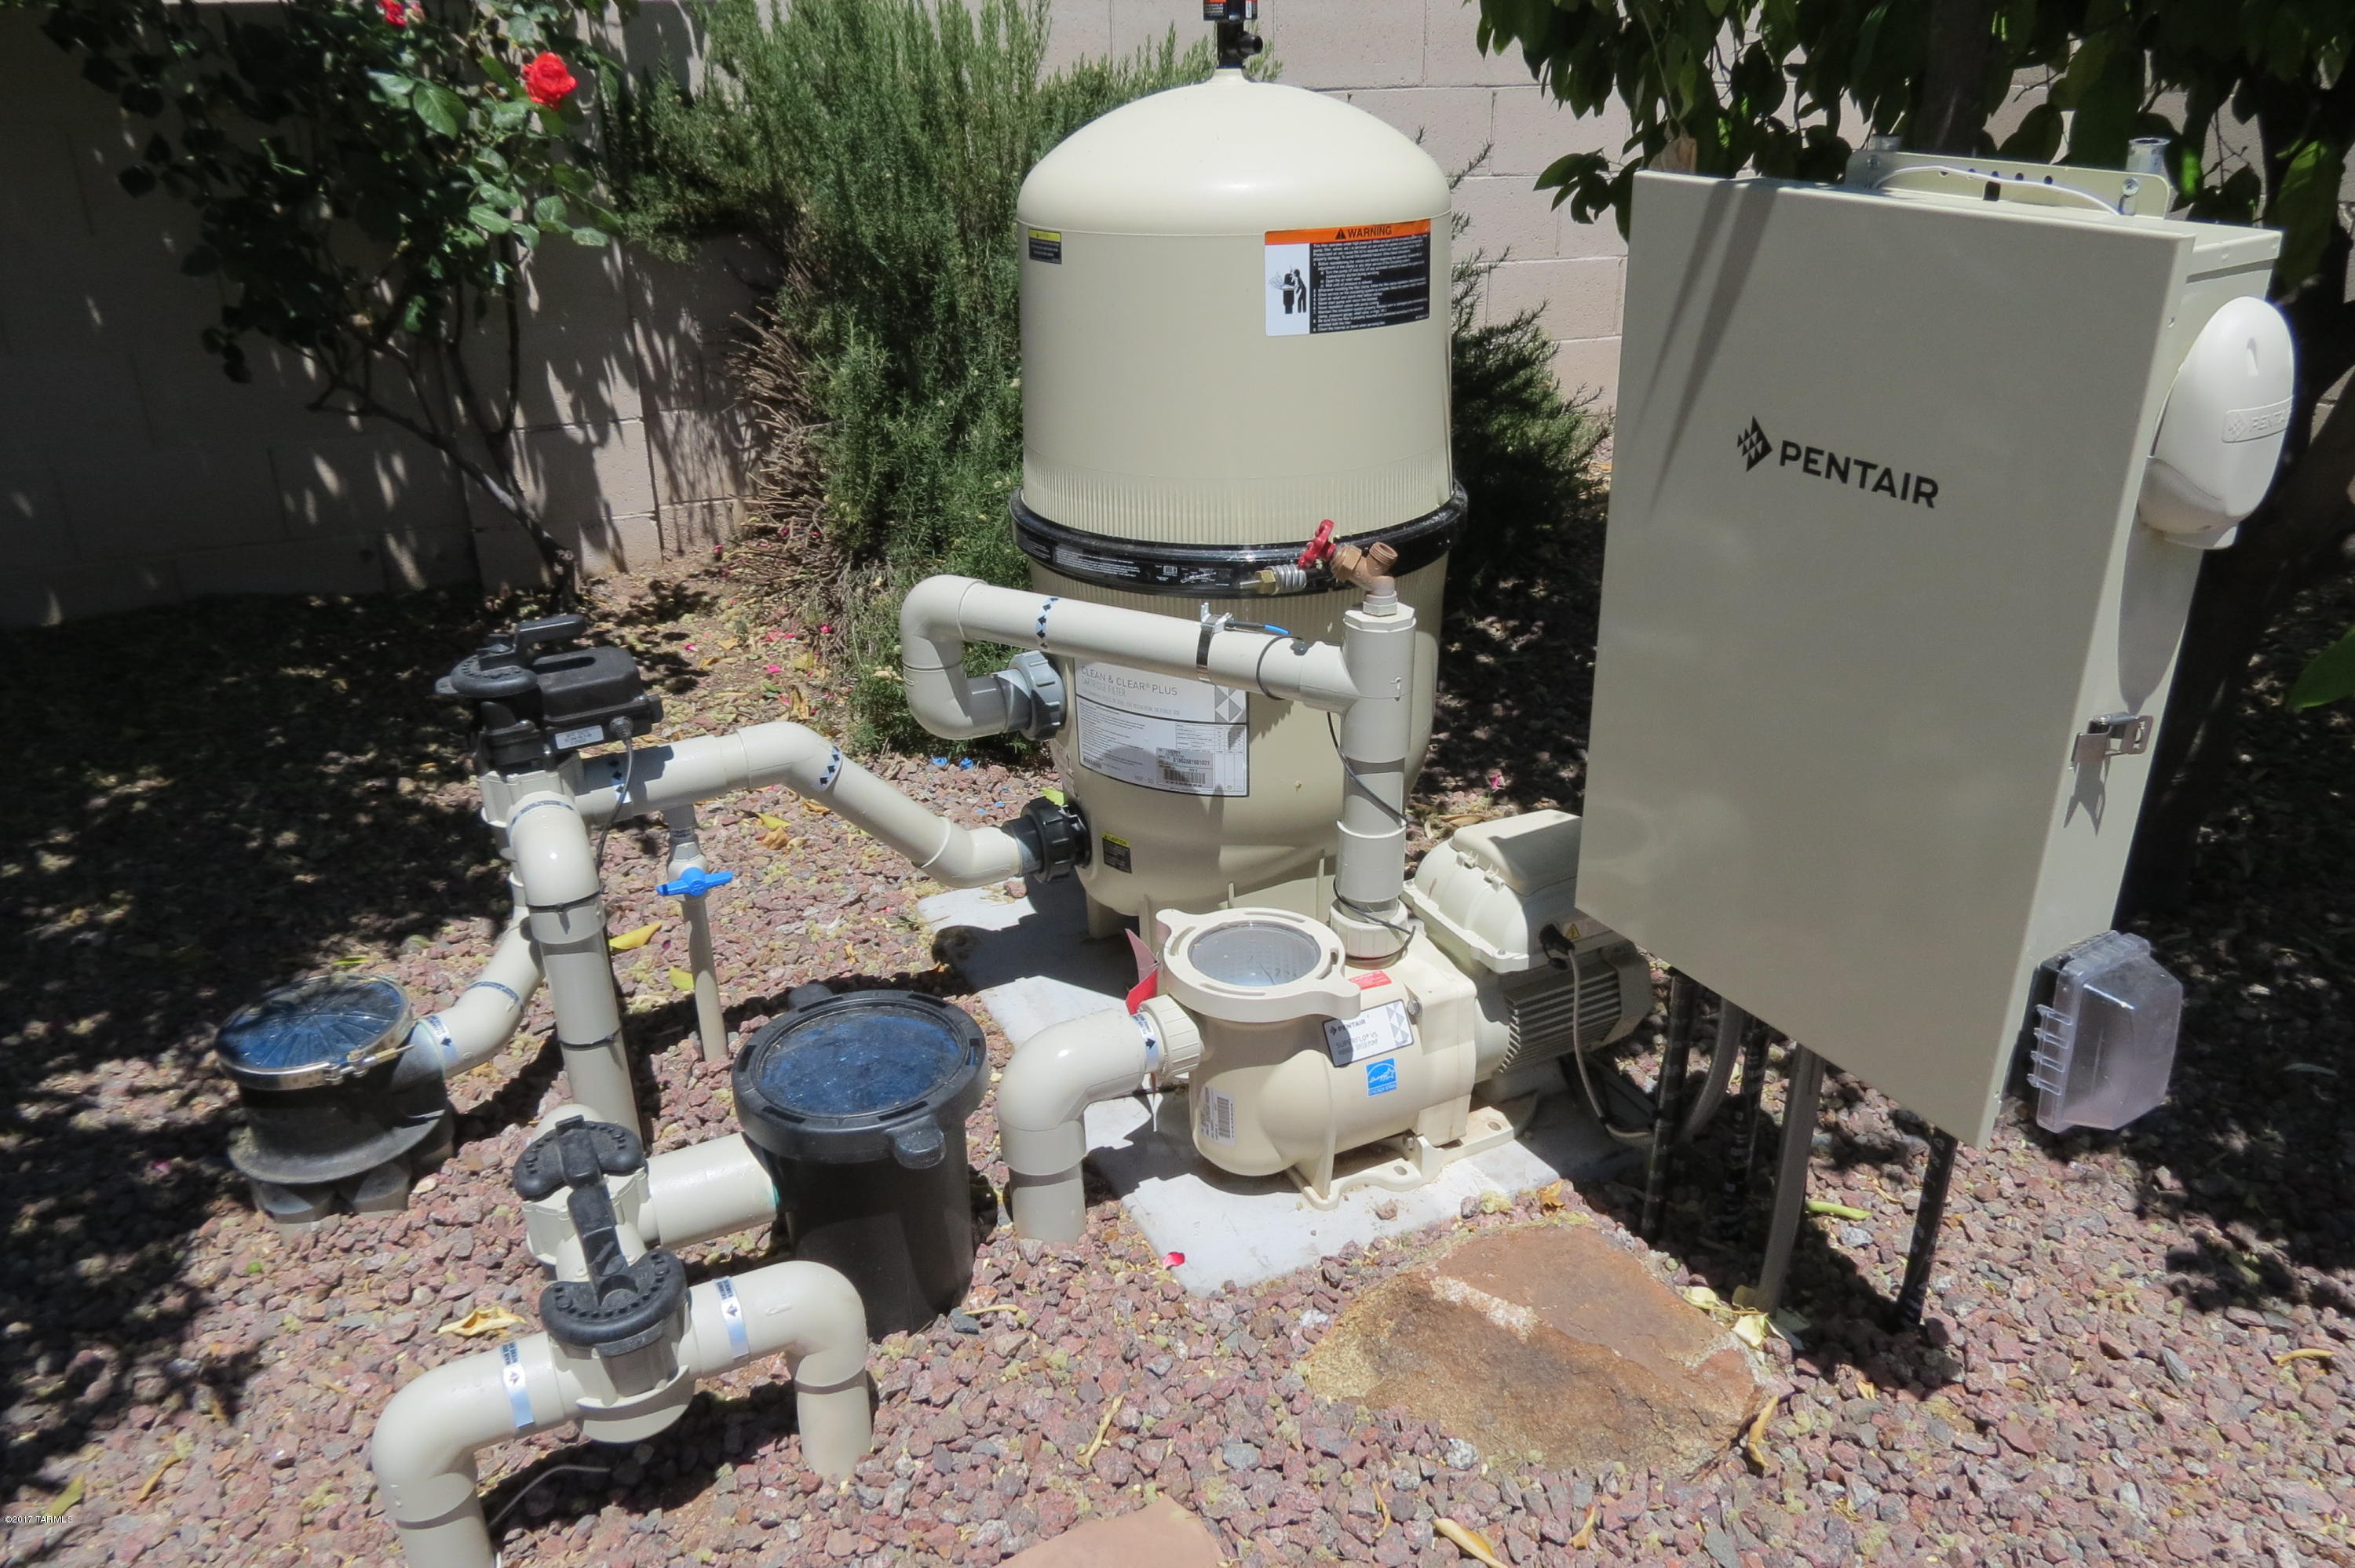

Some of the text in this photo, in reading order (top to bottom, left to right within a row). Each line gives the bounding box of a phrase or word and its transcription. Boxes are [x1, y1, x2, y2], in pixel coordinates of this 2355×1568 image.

[1348, 225, 1392, 239] WARNING
[1780, 439, 1939, 509] PENTAIR
[1081, 665, 1106, 681] CLEAN
[1108, 675, 1114, 684] &
[1152, 684, 1178, 696] PLUS
[1338, 1019, 1366, 1031] PENTAIR
